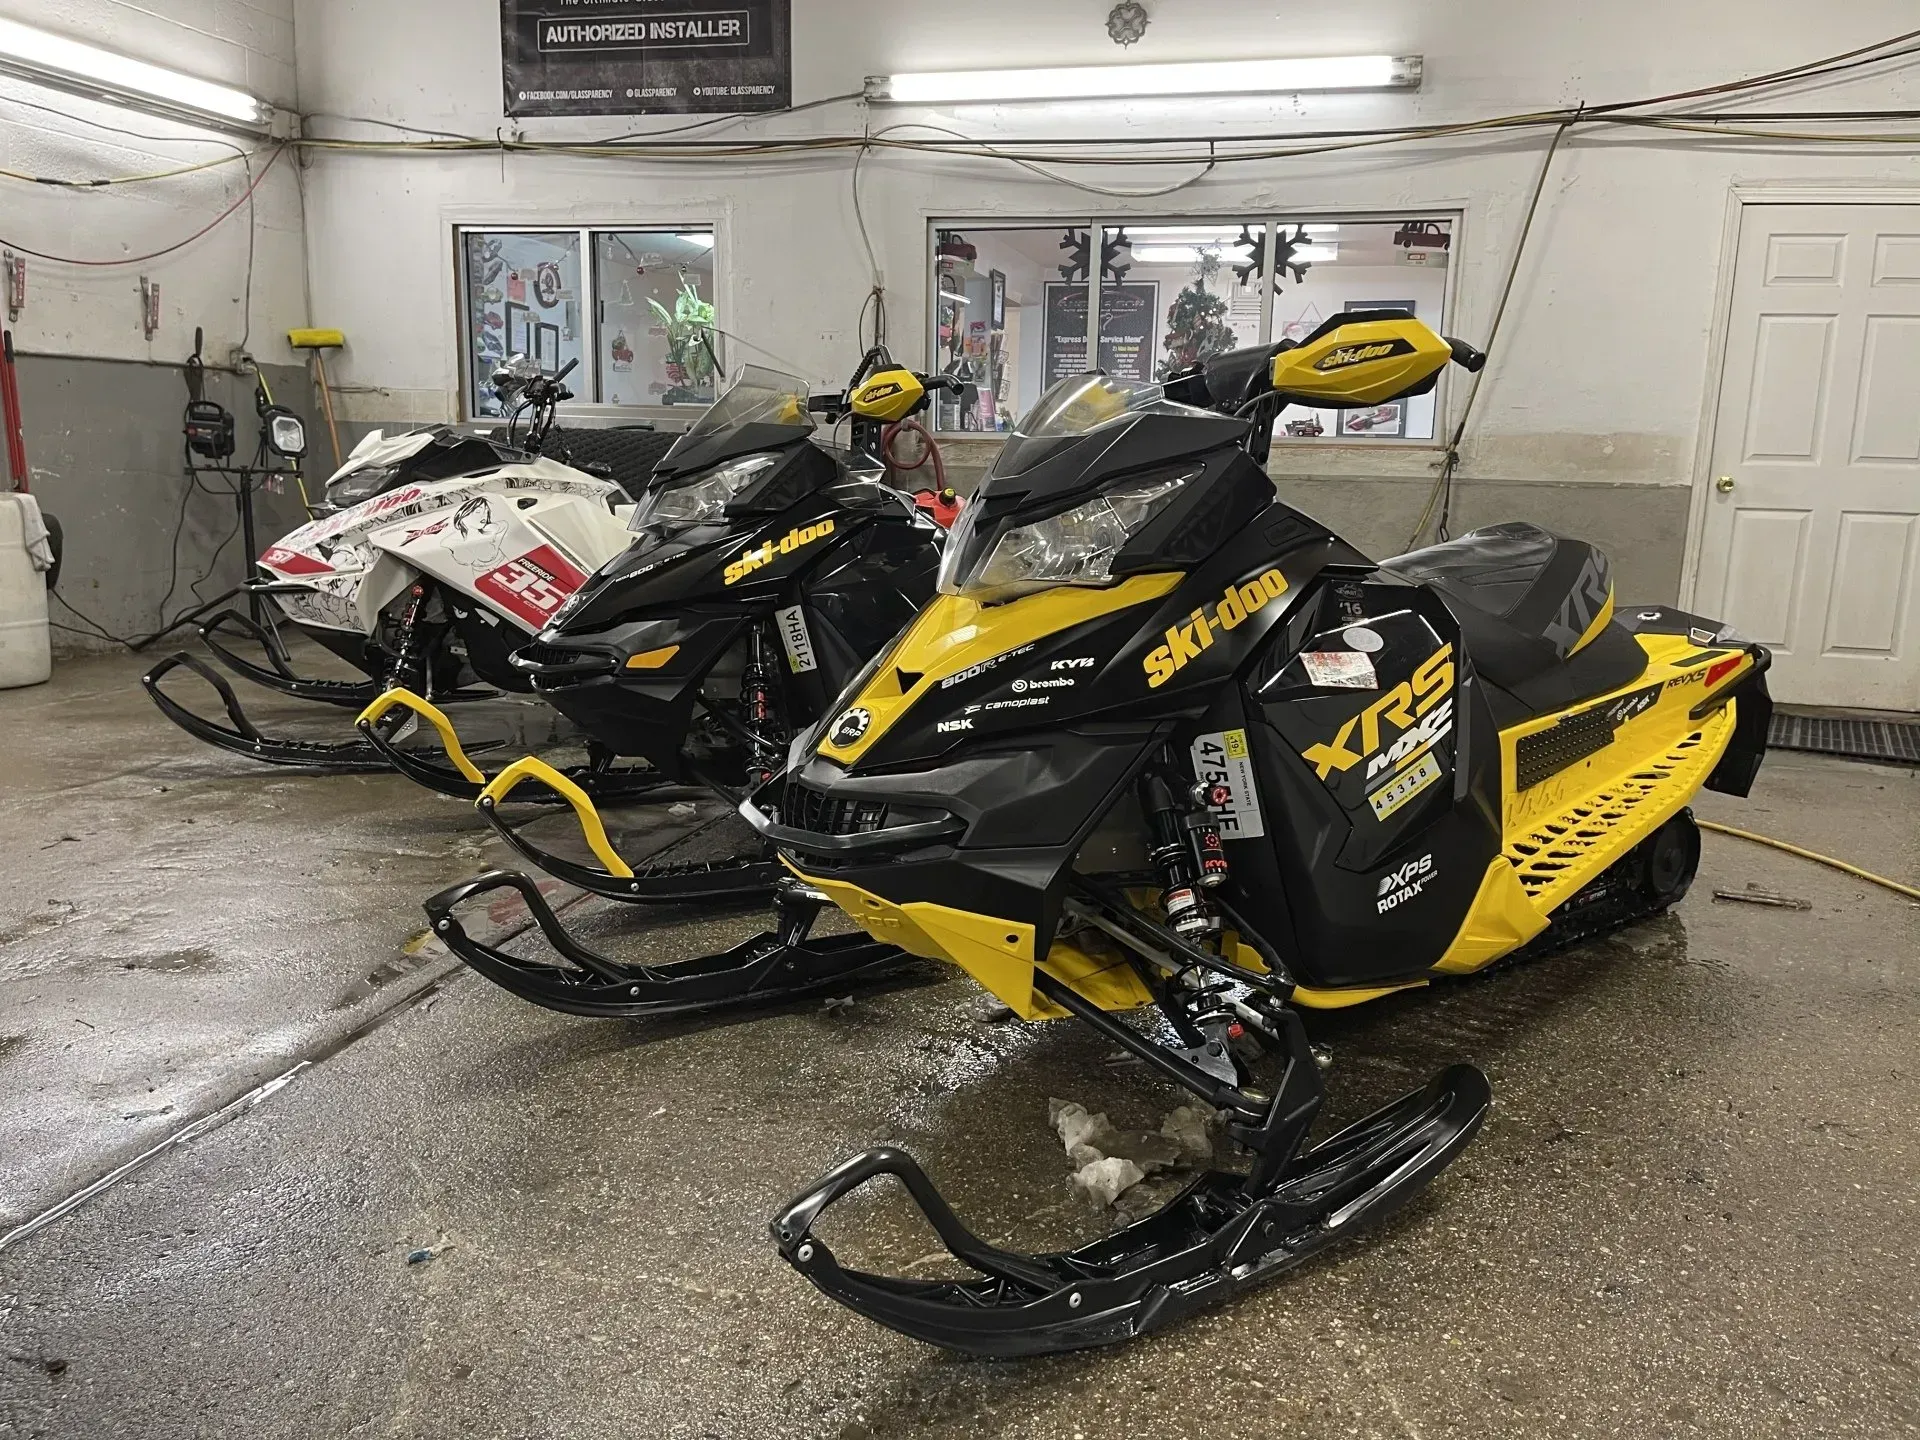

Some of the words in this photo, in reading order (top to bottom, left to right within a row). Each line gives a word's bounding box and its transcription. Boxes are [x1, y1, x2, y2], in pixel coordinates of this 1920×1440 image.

[546, 23, 646, 43] AUTHORIZED
[649, 19, 741, 40] INSTALLER
[526, 89, 613, 101] FACEBOOK.COM/GLASSPARENCY
[634, 87, 677, 98] GLASSPARENCY
[702, 86, 730, 96] YOUTUBE:
[730, 85, 775, 95] GLASSPARENCY
[1322, 343, 1394, 368] ski-doo
[724, 519, 835, 586] ski-doo
[517, 558, 556, 583] FREERIDE
[785, 609, 812, 668] 2118HA
[1143, 568, 1289, 689] ski-doo
[941, 659, 997, 689] 800R
[1050, 657, 1095, 671] KYB
[1029, 677, 1075, 689] brembo
[984, 696, 1050, 711] camoplast
[1301, 641, 1455, 782] XRS
[841, 726, 862, 737] BRP
[937, 718, 974, 733] NSK
[1240, 774, 1249, 791] YORK
[1243, 790, 1252, 807] STATE
[1389, 853, 1432, 891] XPS
[1377, 880, 1423, 914] ROTAX
[1420, 869, 1438, 885] POWER
